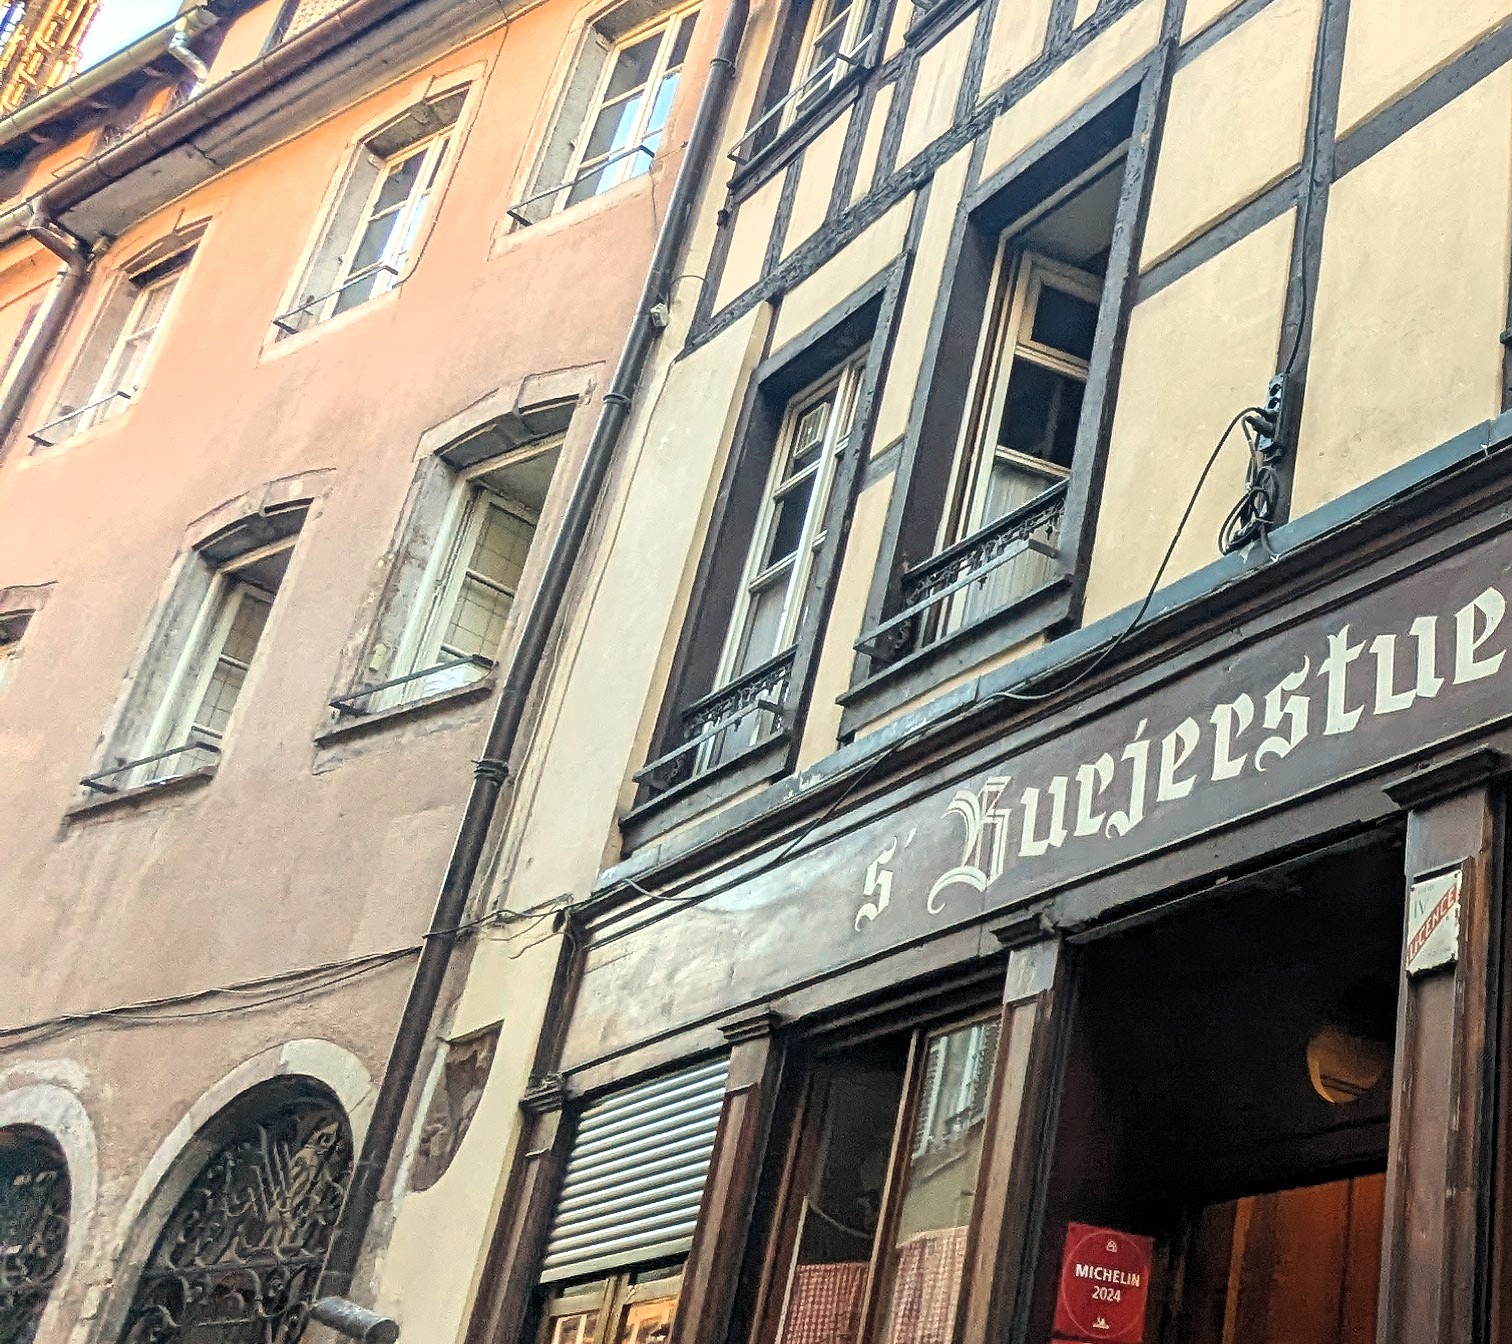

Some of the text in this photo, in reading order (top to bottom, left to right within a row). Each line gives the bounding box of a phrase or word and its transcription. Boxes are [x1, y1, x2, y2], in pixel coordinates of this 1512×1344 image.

[1409, 885, 1456, 960] LICENCE
[1075, 1263, 1140, 1287] MICHELIN
[1091, 1285, 1121, 1303] 2024
